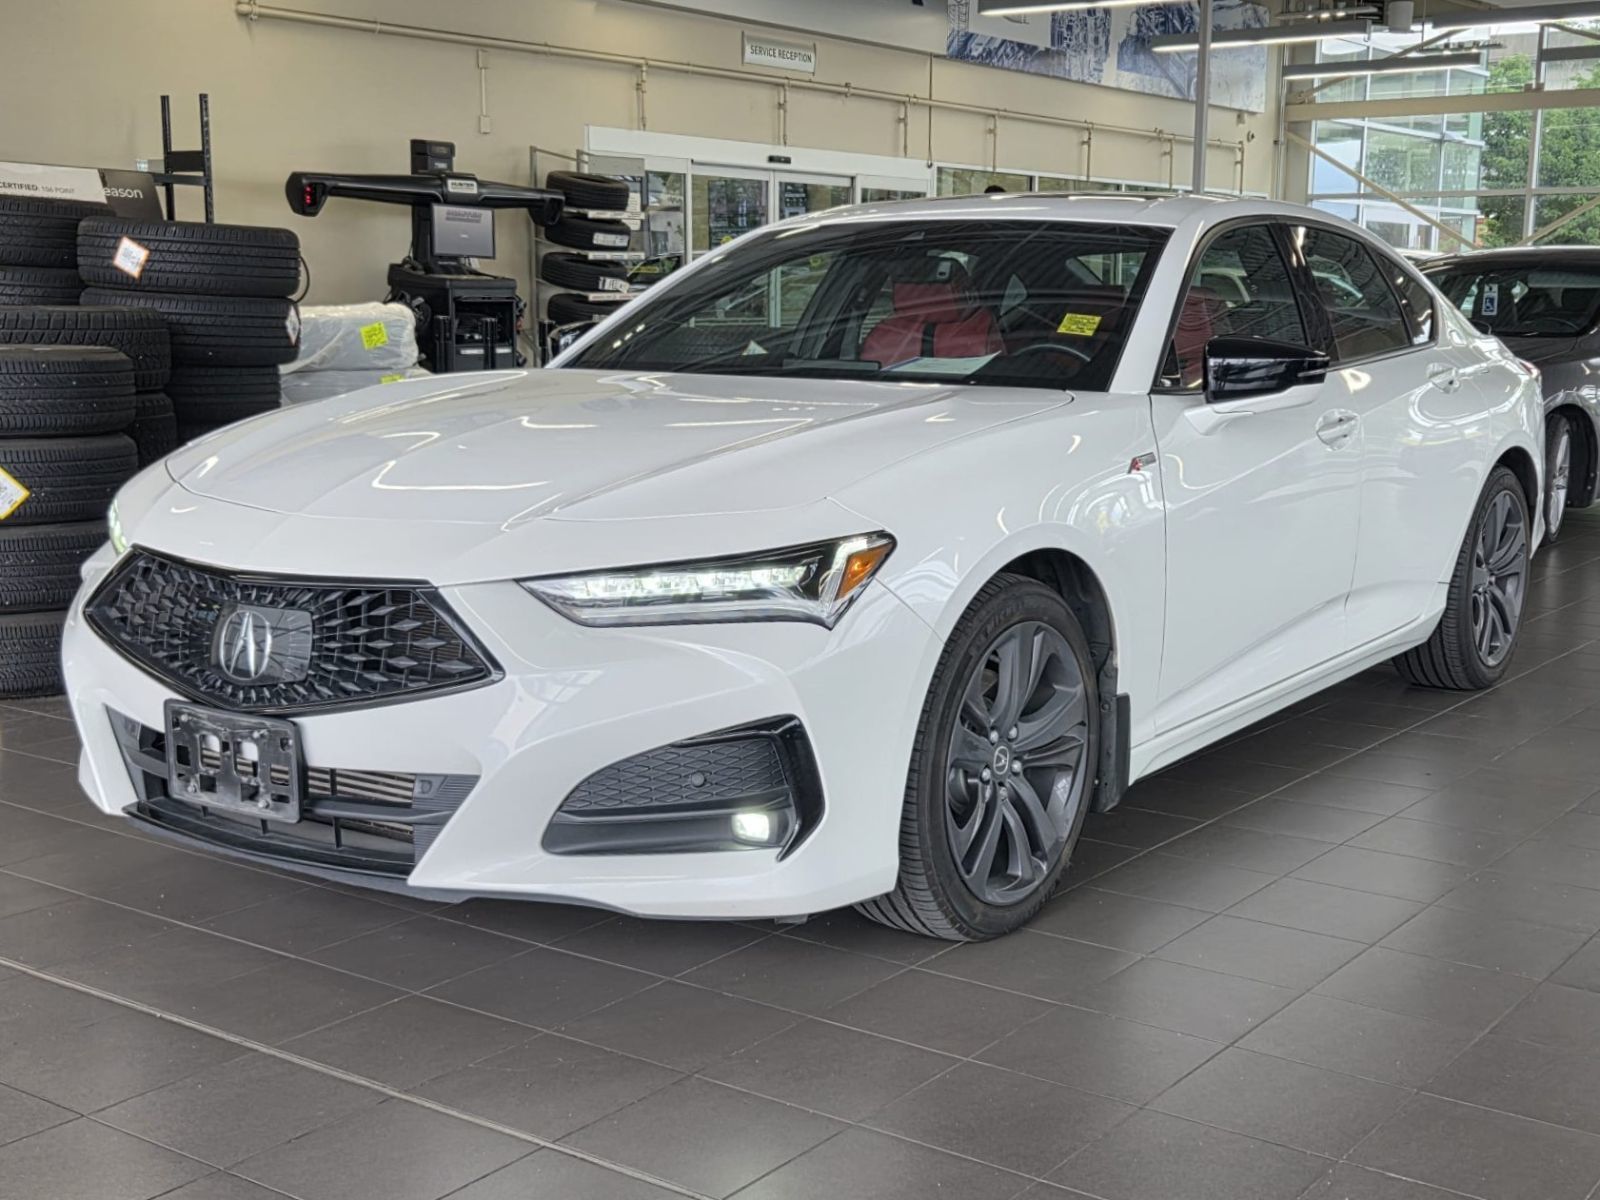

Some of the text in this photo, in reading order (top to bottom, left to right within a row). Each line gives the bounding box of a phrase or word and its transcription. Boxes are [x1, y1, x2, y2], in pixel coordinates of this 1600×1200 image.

[750, 45, 812, 63] SERVICE RECEPTION
[0, 181, 38, 191] CERTIFIED
